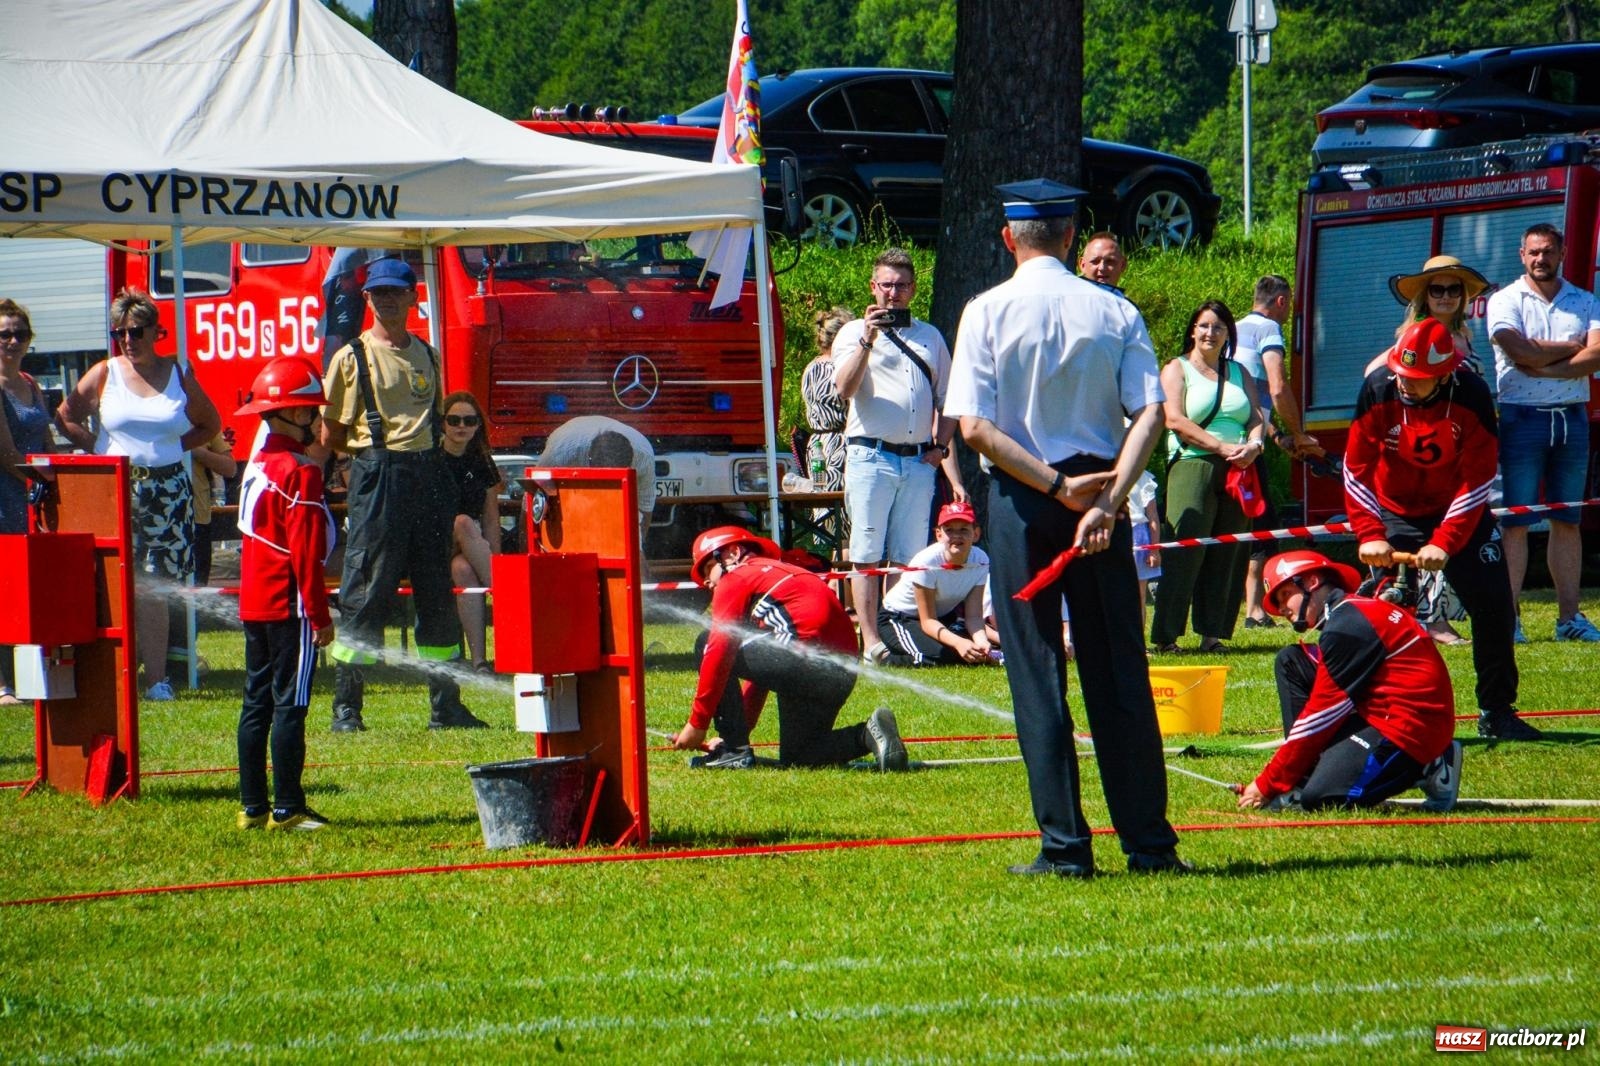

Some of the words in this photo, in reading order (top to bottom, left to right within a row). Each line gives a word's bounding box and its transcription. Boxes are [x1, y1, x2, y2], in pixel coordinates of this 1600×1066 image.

[0, 172, 62, 213] SP
[101, 172, 400, 219] CYPRZANÓW
[1315, 197, 1349, 213] Camiva
[1366, 193, 1407, 209] OCHOTNICZA
[1407, 186, 1427, 206] STRAŻ
[1427, 183, 1457, 202] POŻARNA
[1457, 184, 1465, 199] W
[1464, 178, 1520, 199] SAMBOROWICACH
[1520, 176, 1534, 192] TEL.
[1535, 175, 1548, 190] 112
[195, 300, 256, 361] 569
[279, 296, 319, 356] 56
[1414, 431, 1442, 464] 5
[656, 481, 681, 497] 5YW
